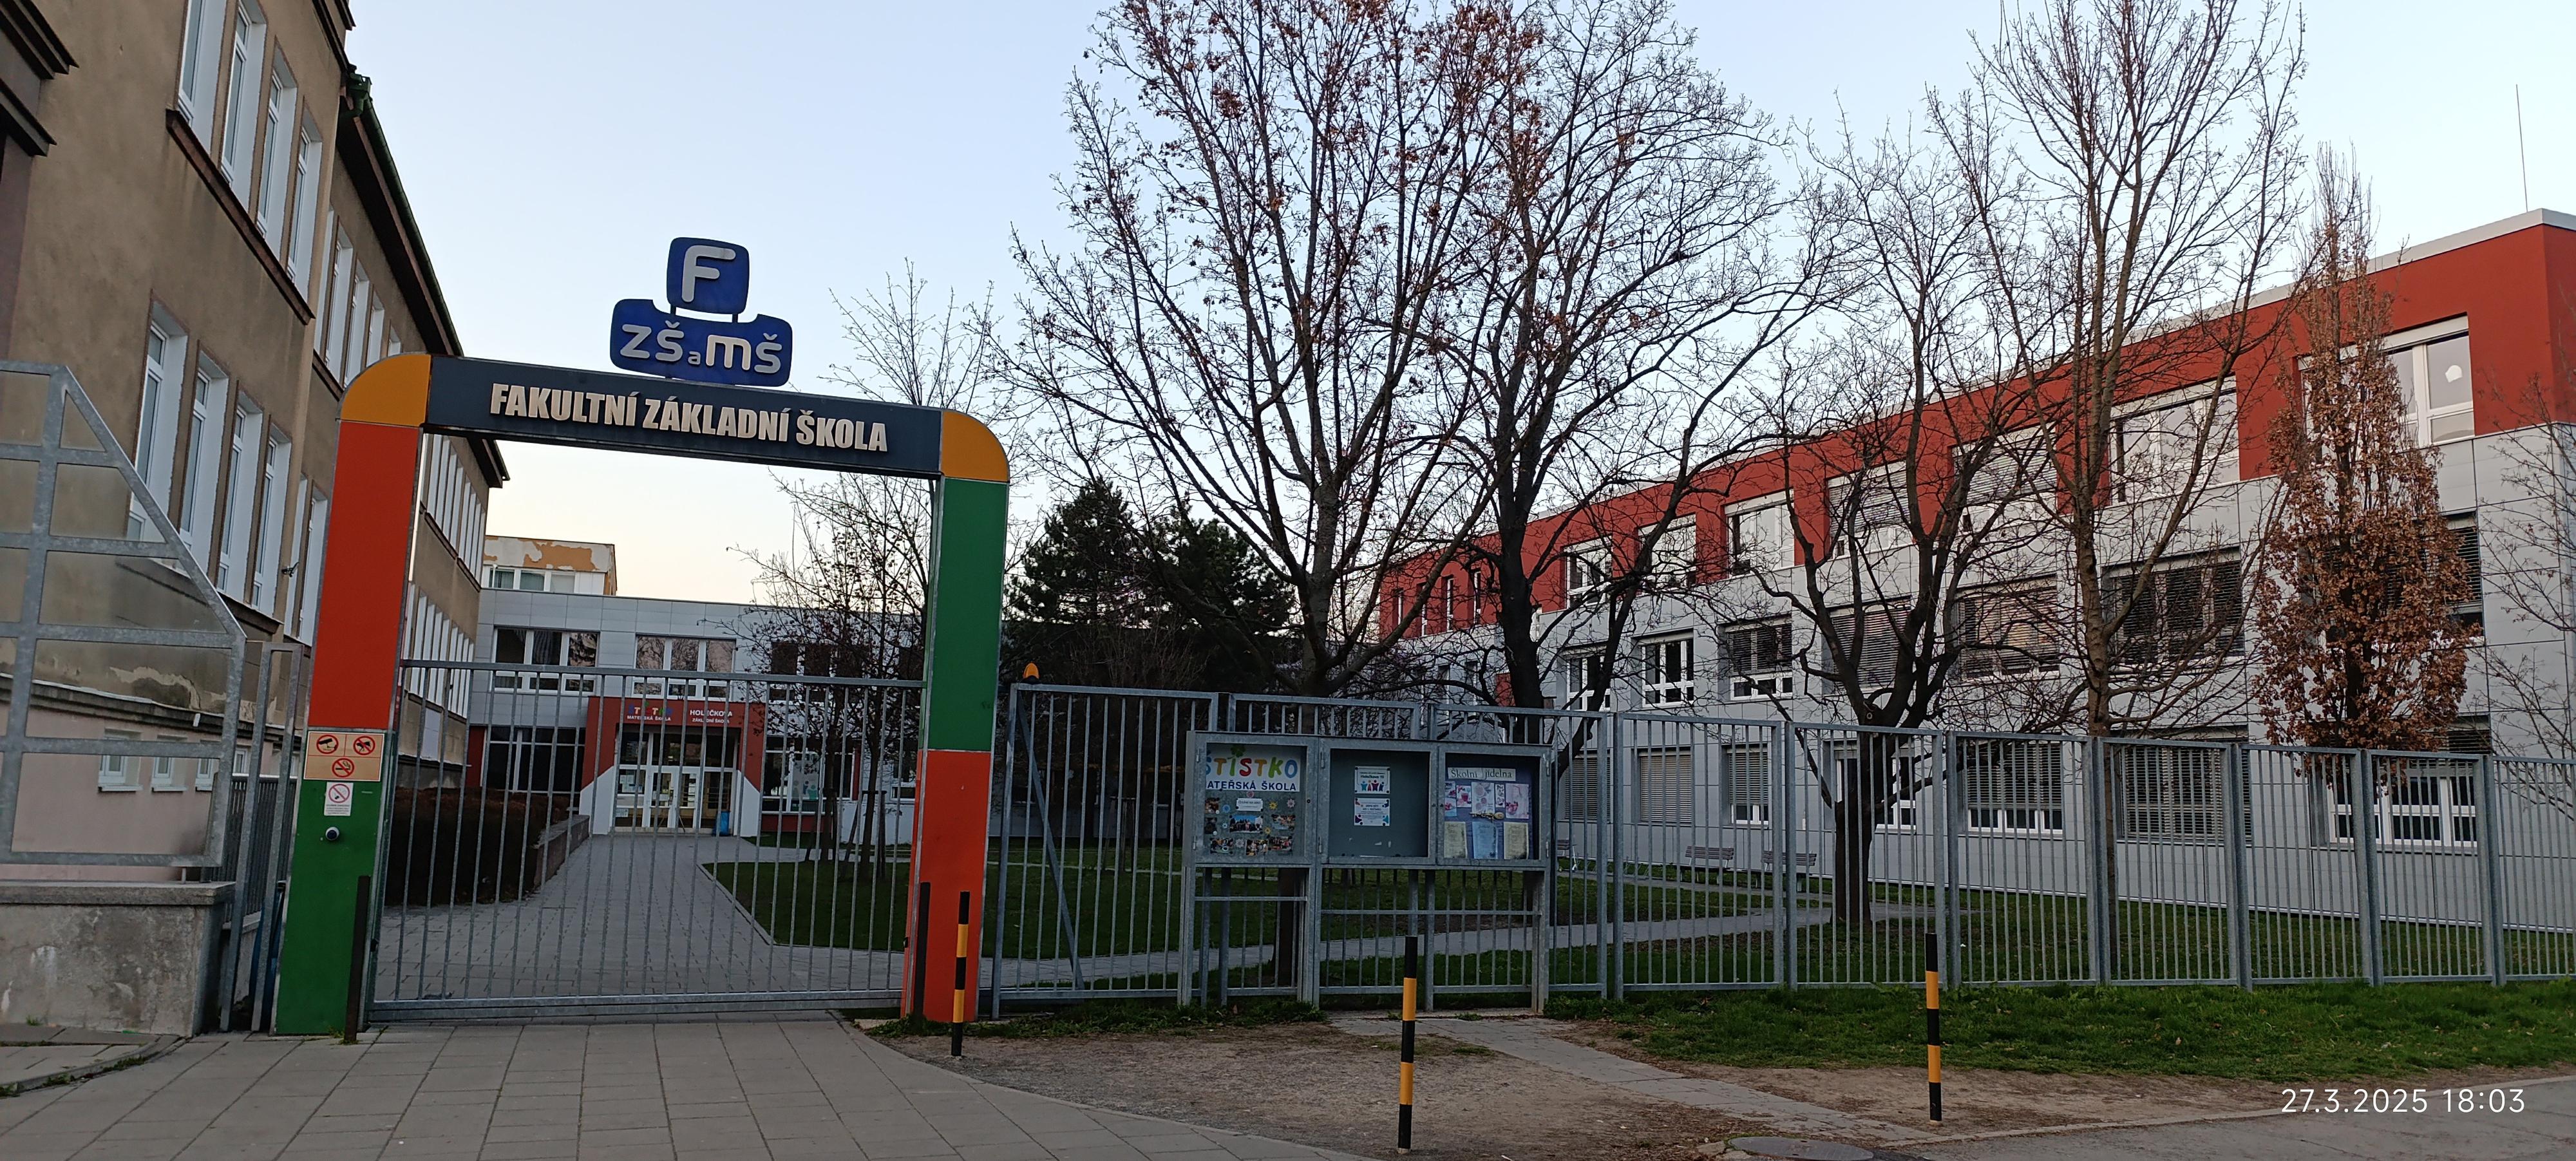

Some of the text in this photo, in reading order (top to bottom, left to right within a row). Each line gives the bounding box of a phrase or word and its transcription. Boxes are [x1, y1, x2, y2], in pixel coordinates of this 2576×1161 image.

[681, 245, 736, 303] F
[490, 383, 887, 451] FAKULTNÍ ZÁKLADNÍ ŠKOLA
[1207, 779, 1296, 791] ATEŘSKÁ ŠKOLA
